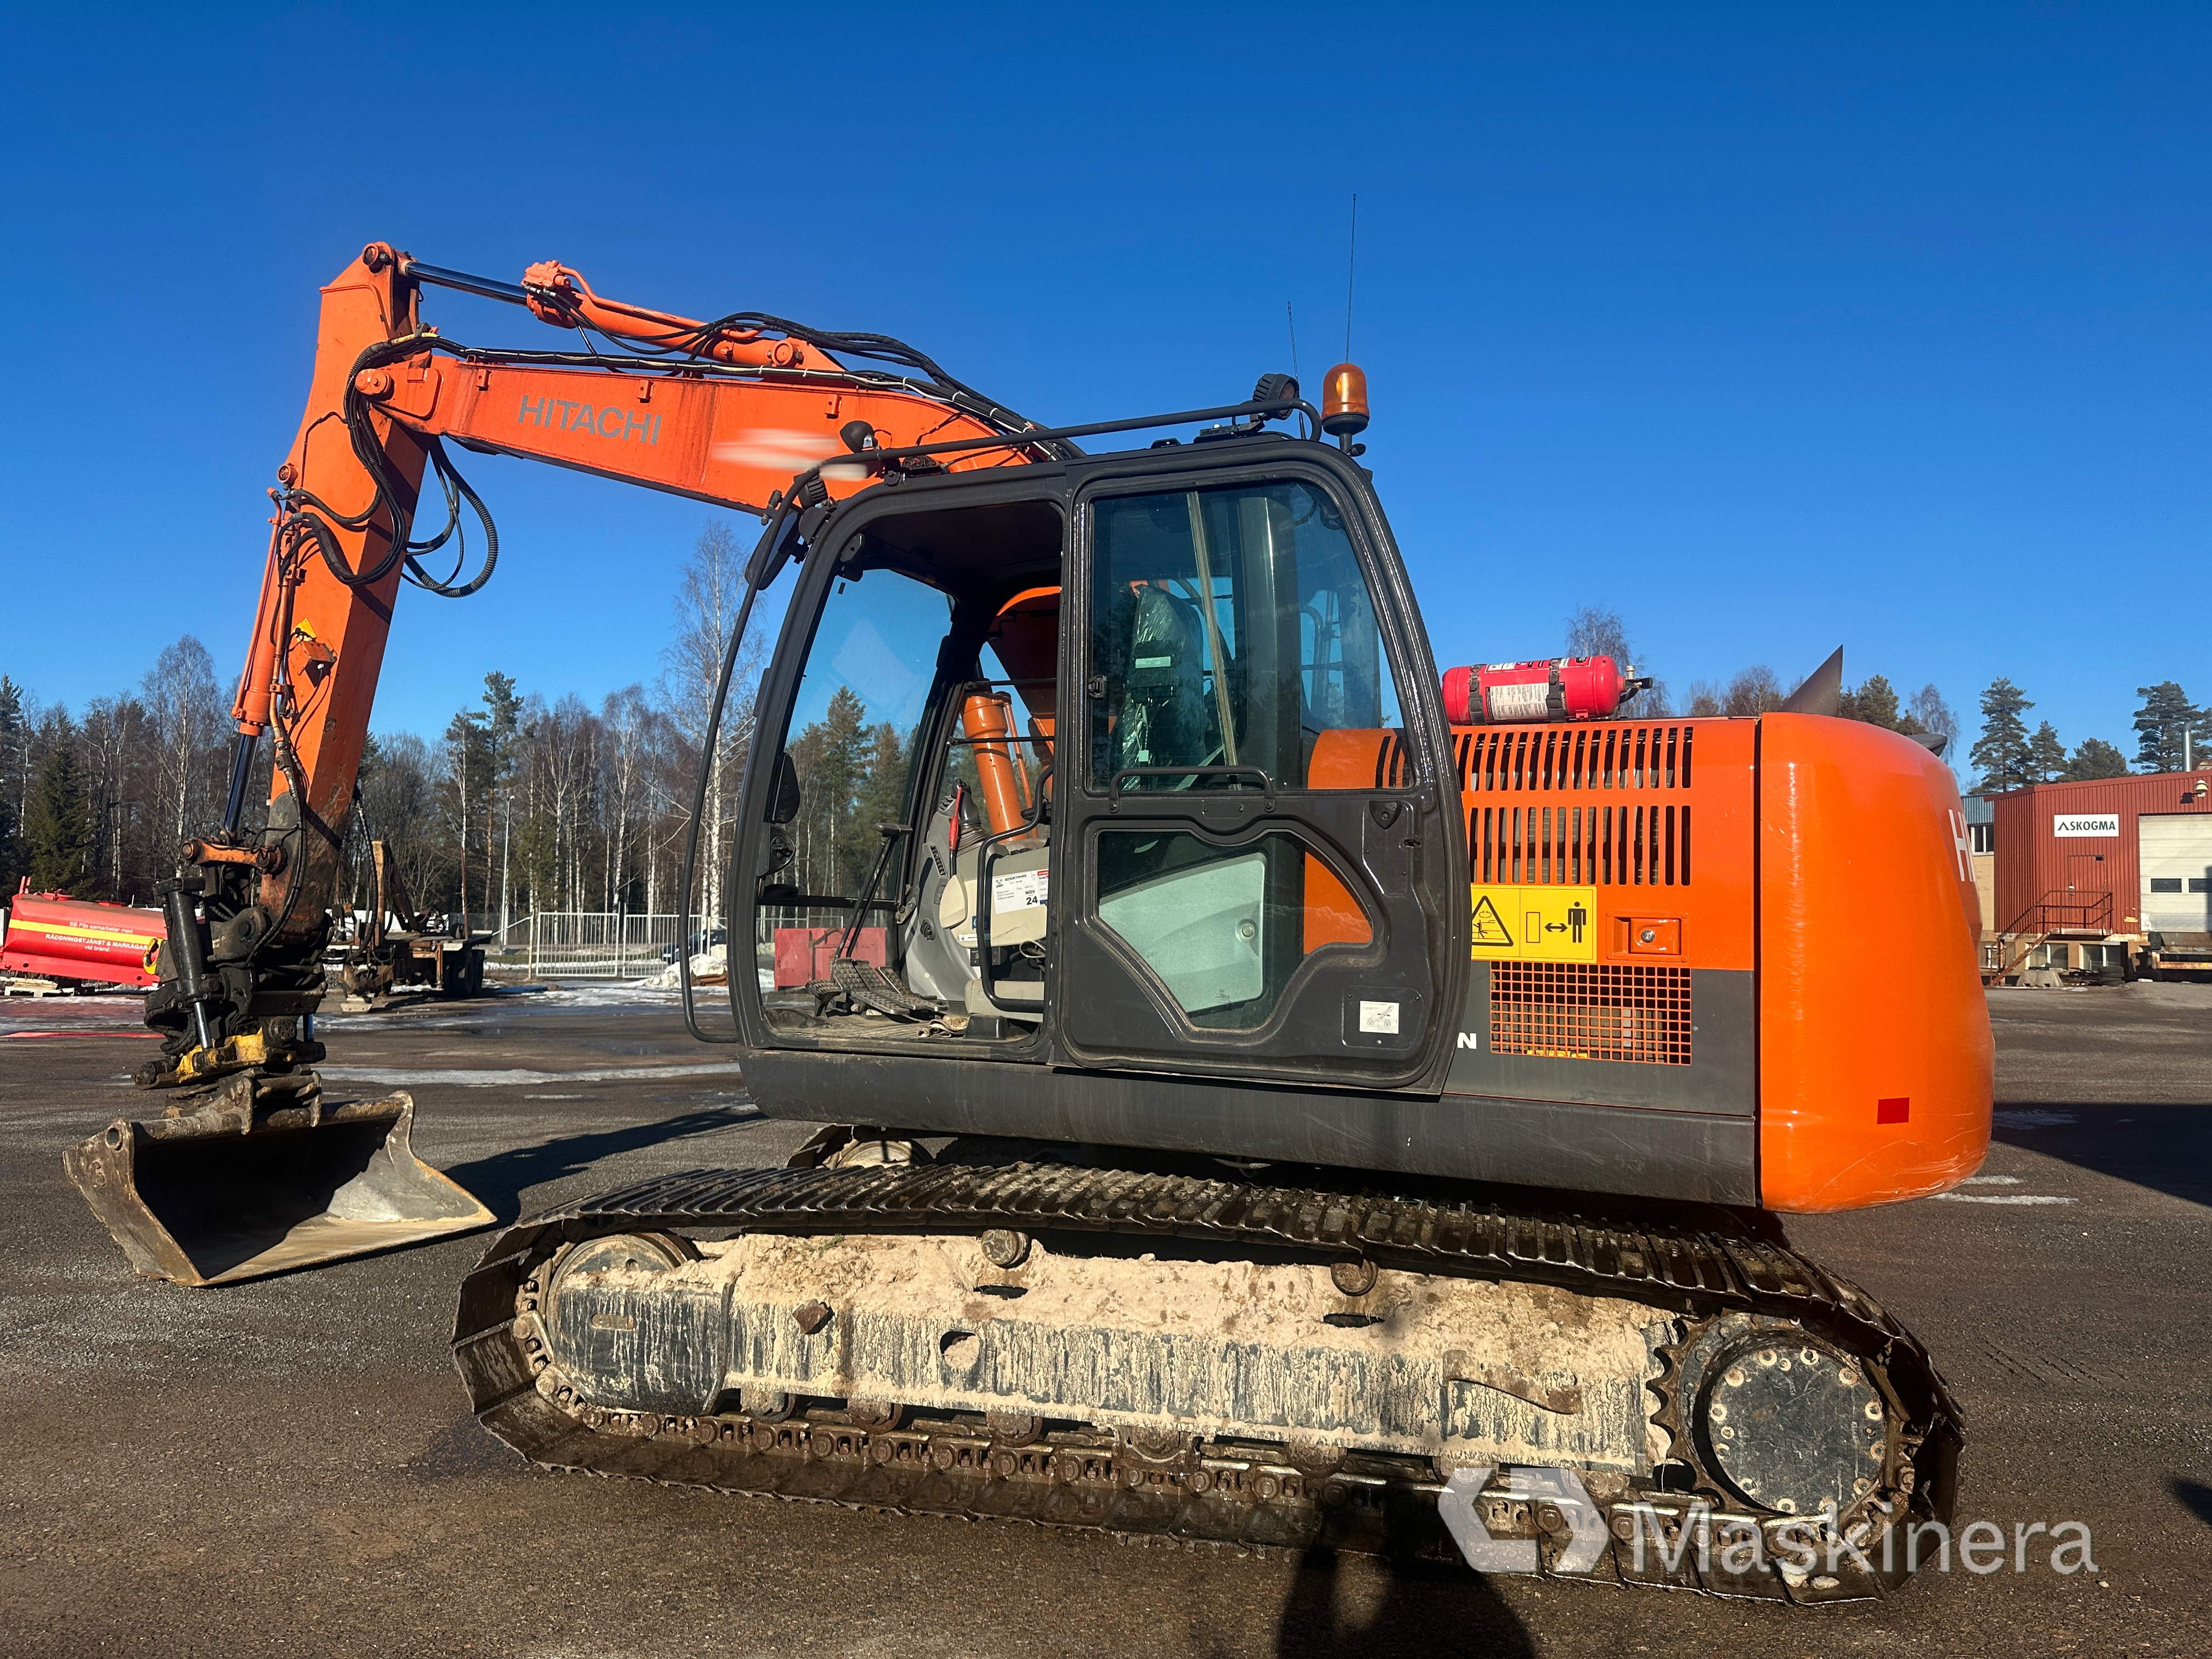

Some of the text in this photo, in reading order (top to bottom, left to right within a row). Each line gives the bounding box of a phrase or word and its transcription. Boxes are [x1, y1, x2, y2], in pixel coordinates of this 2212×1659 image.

[518, 395, 662, 445] HITACHI
[1026, 896, 1038, 905] 24
[89, 924, 120, 933] samarbetar
[46, 933, 105, 945] RÄDDNINGSTJÄNST
[112, 941, 148, 950] MARKÄGAR
